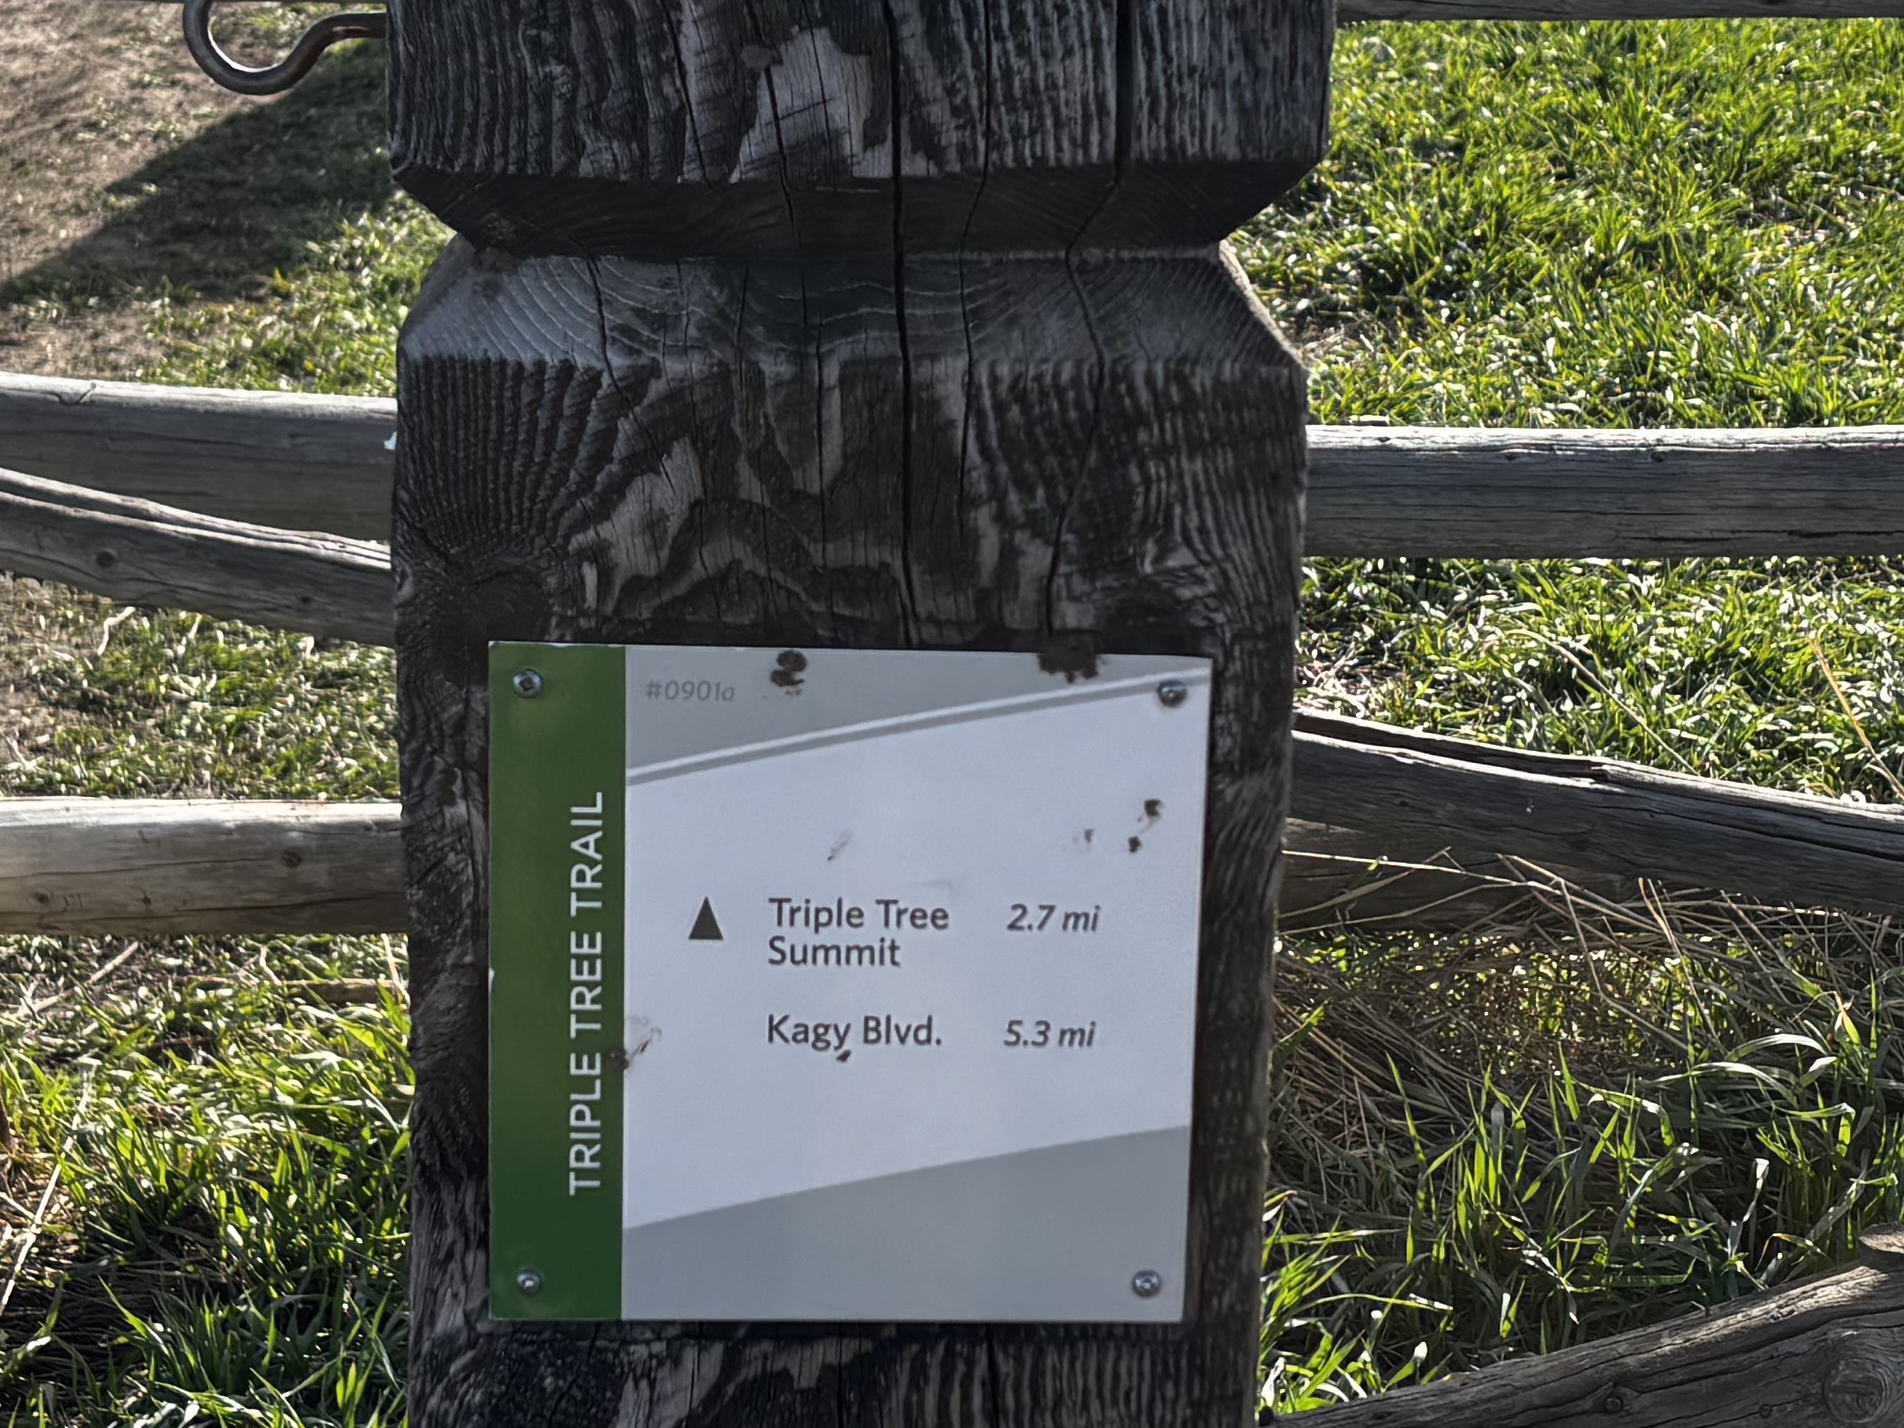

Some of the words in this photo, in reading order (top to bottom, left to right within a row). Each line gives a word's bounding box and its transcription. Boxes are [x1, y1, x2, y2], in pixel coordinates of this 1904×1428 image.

[645, 679, 735, 702] #0901a
[570, 792, 604, 917] TRAIL
[768, 897, 864, 933] Triple
[875, 899, 950, 929] Tree
[1007, 903, 1056, 932] 2.7
[1062, 905, 1101, 932] mi
[768, 935, 901, 966] Summit
[570, 931, 603, 1039] TREE
[767, 1014, 851, 1051] Kagy
[862, 1014, 942, 1045] Blvd.
[1003, 1020, 1051, 1047] 5.3
[1058, 1021, 1096, 1047] mi
[569, 1052, 602, 1196] TRIPLE
